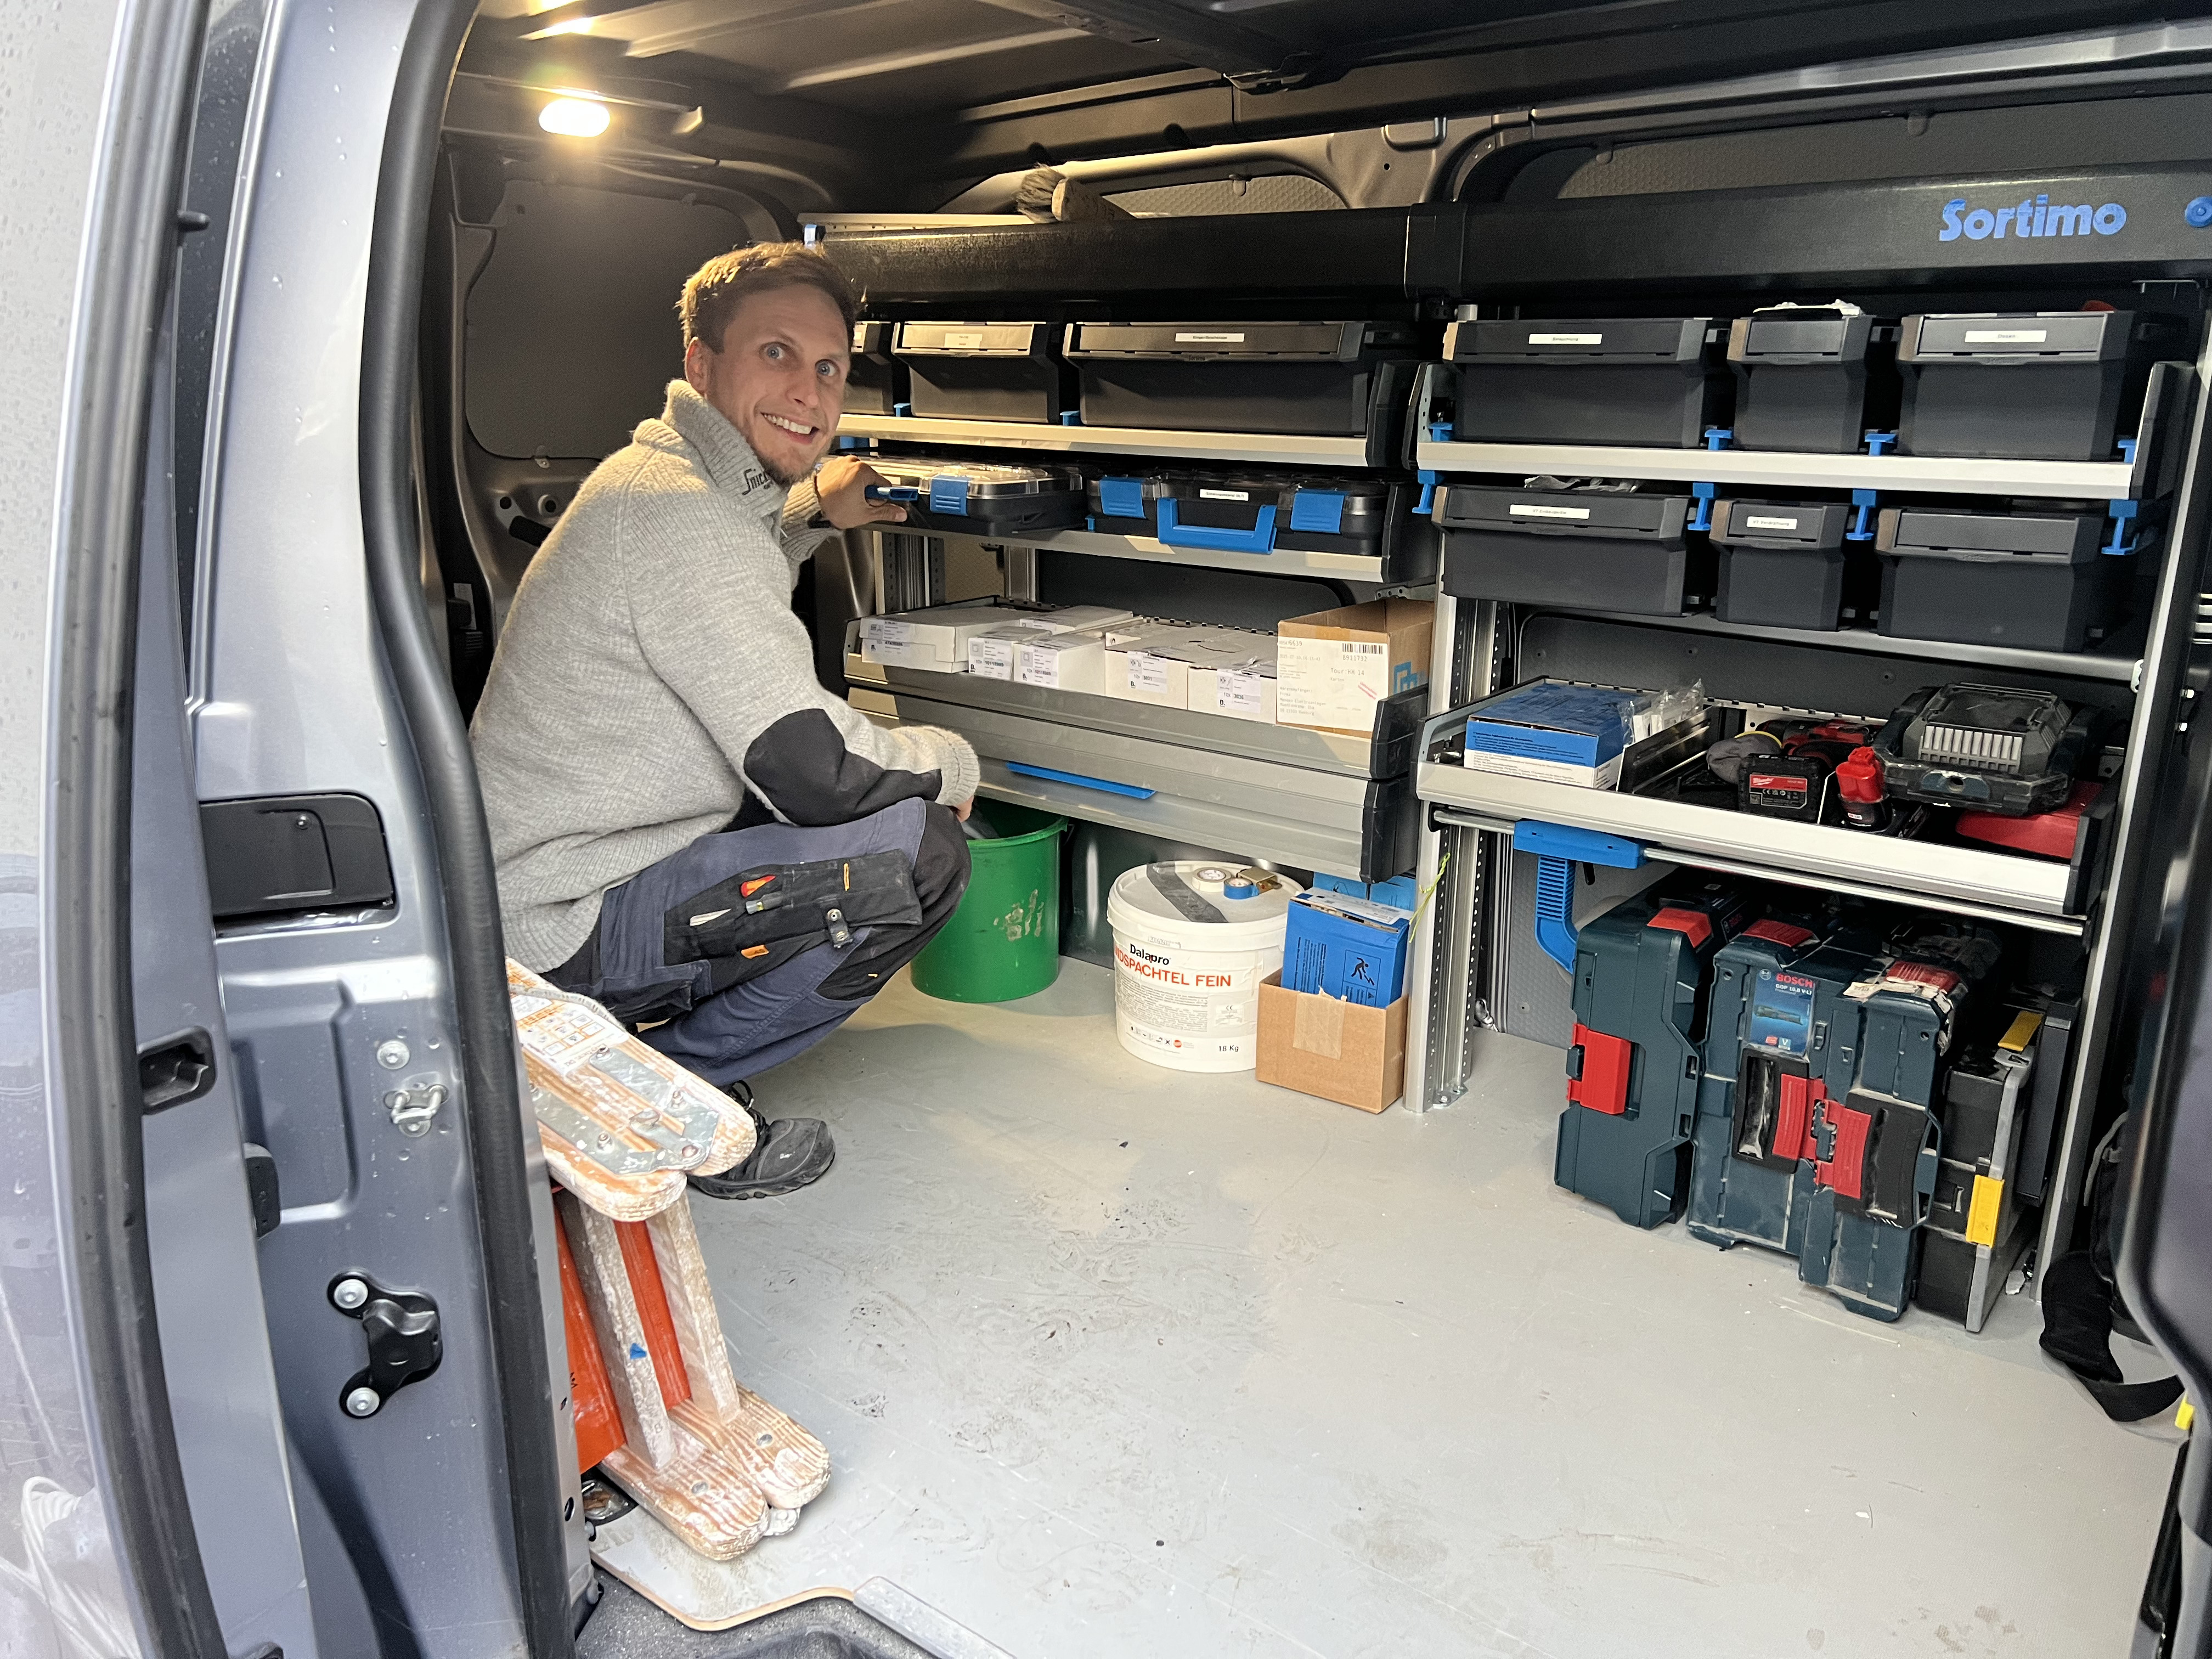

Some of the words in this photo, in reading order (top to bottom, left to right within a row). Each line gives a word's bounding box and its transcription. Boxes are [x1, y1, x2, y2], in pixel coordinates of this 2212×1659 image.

[1939, 194, 2127, 241] Sortimo
[1130, 944, 1170, 966] Dalapro
[1195, 975, 1231, 987] FEIN
[1776, 973, 1813, 989] BOSCH
